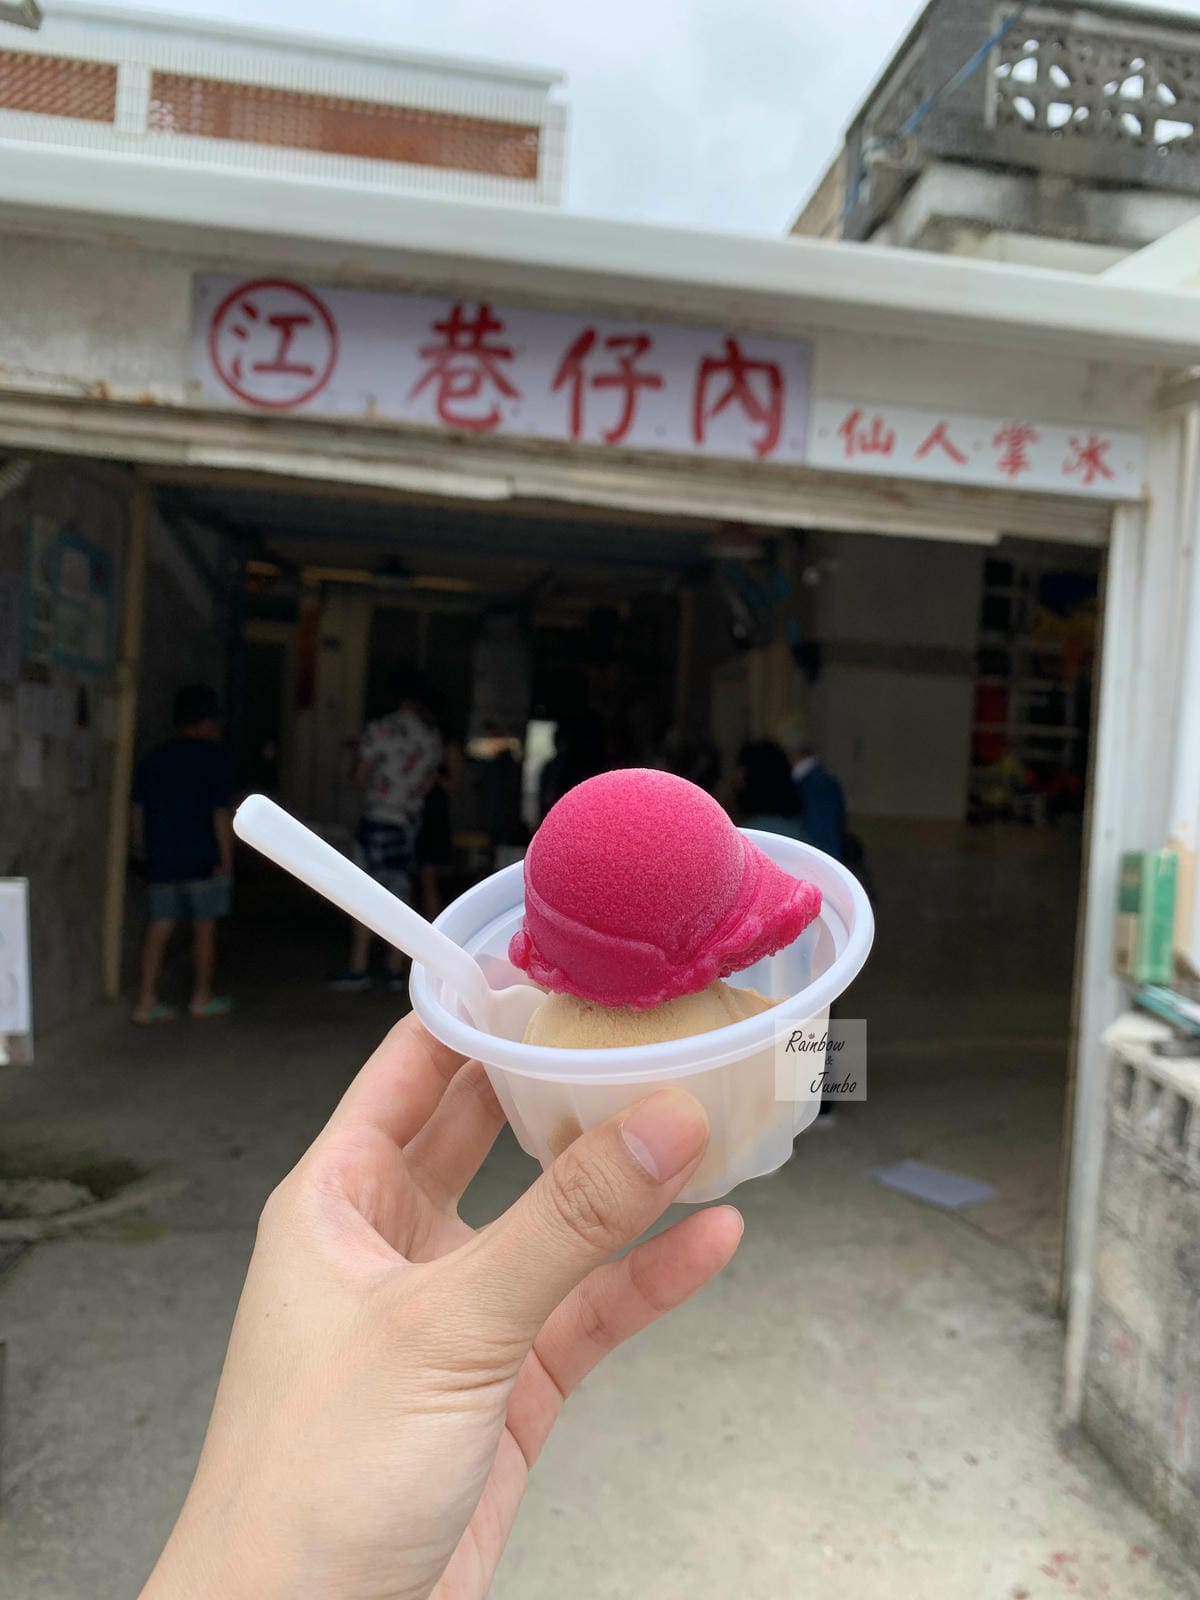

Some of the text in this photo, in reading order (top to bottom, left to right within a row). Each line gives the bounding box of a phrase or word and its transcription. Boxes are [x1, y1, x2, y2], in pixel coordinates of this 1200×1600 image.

[230, 301, 315, 380] 江
[836, 408, 1115, 484] 仙人掌冰
